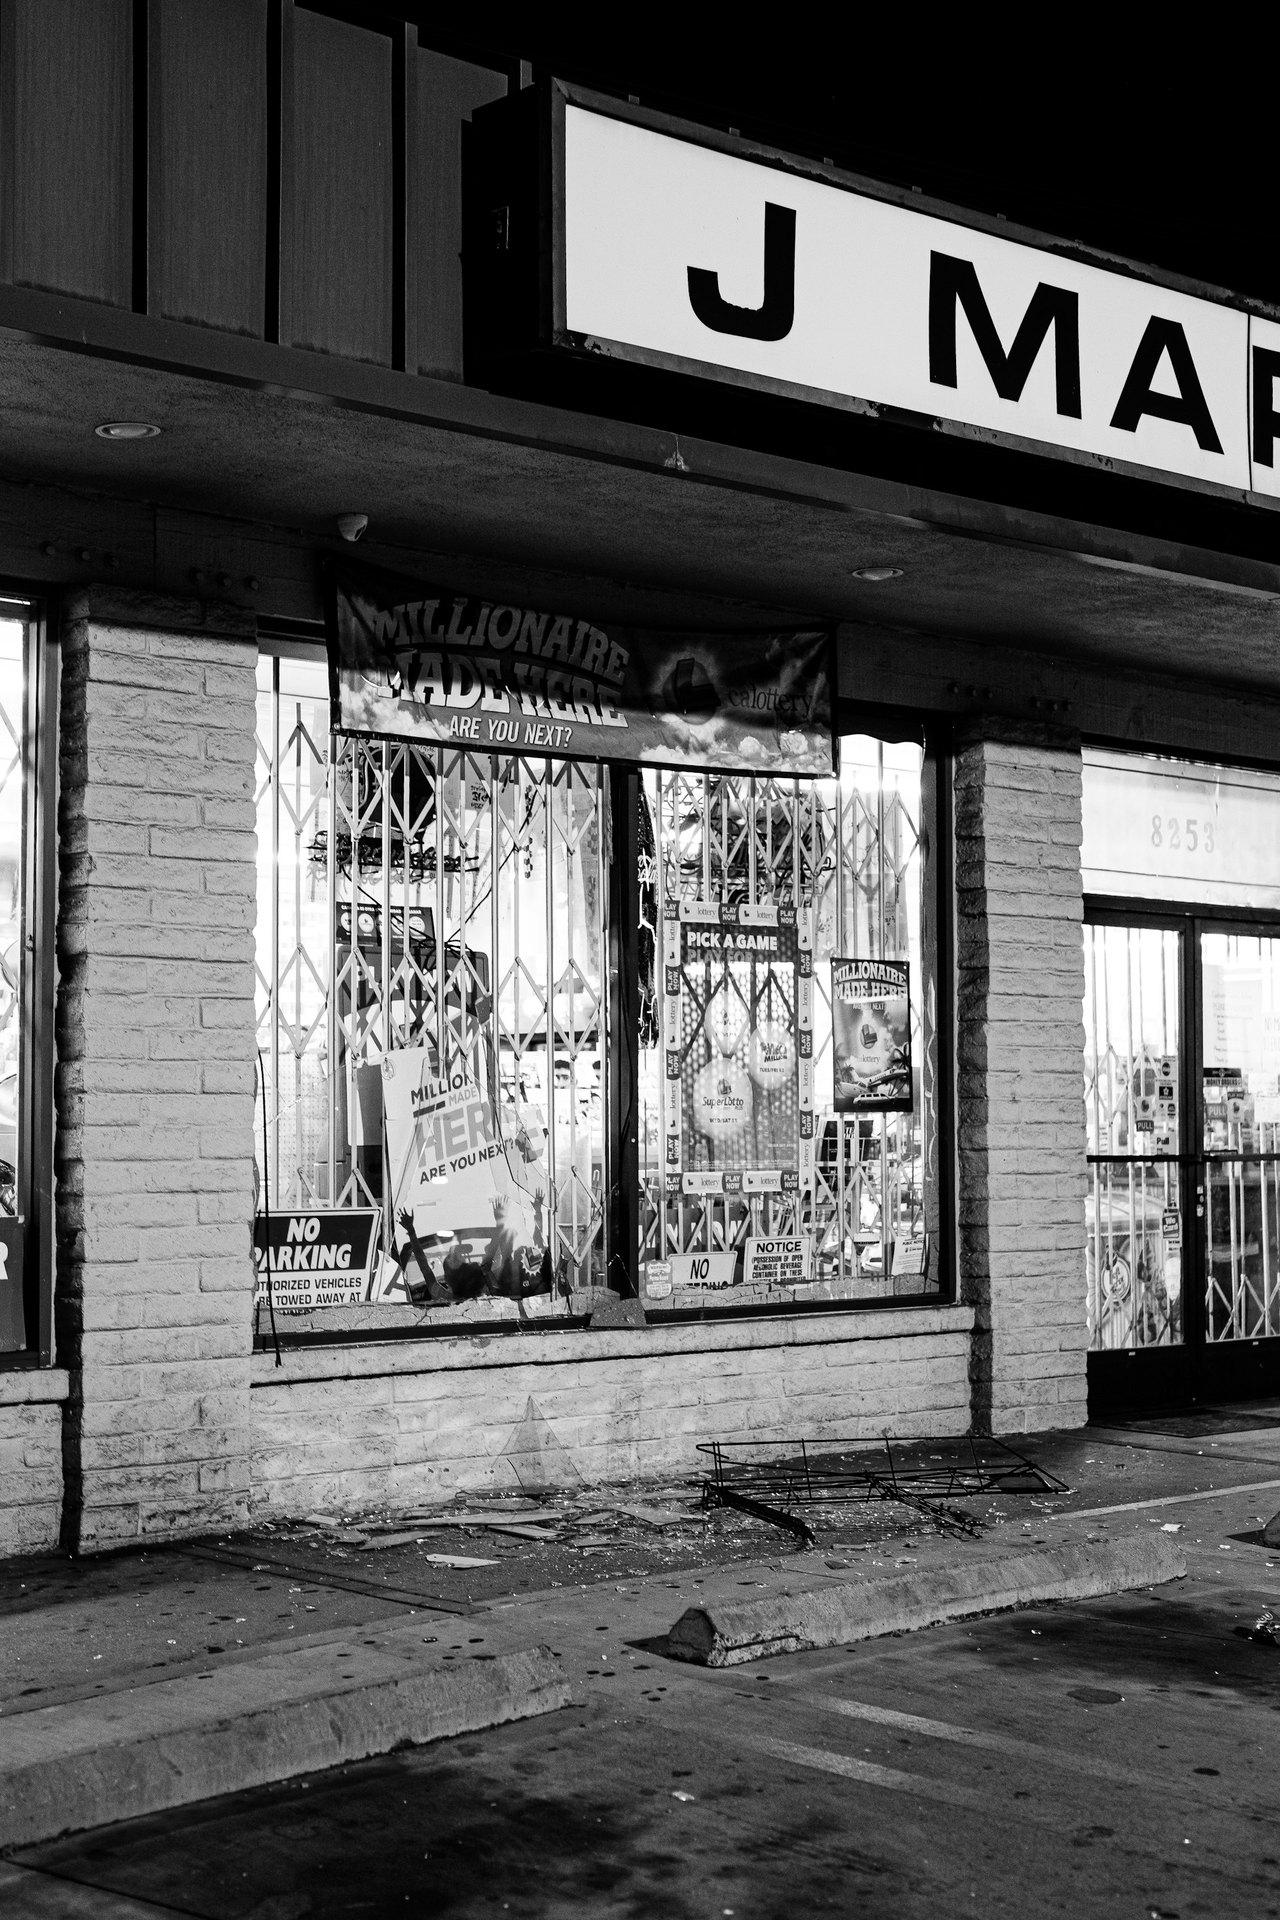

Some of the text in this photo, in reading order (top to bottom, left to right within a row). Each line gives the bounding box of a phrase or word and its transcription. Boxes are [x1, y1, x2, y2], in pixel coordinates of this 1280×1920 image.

[687, 200, 797, 342] J
[374, 597, 631, 685] MILLIONAIRE
[377, 651, 629, 728] MADE HERE
[727, 684, 813, 719] calottery
[450, 715, 573, 748] ARE YOU NEXT?
[1151, 814, 1215, 854] 8253
[697, 905, 716, 917] lottery
[757, 910, 774, 921] lottery
[687, 932, 777, 950] PICK A GAME
[833, 961, 907, 986] MILLIONAIRE
[834, 981, 907, 999] MADE HERE
[862, 1055, 881, 1065] lottery
[449, 1087, 478, 1106] MADE
[702, 1096, 744, 1109] SuperLotto
[1208, 1106, 1227, 1116] PULL
[1137, 1121, 1154, 1130] PULL
[1157, 1137, 1169, 1145] Pull
[420, 1164, 447, 1184] ARE
[450, 1153, 476, 1172] YOU
[701, 1178, 720, 1188] lottery
[760, 1176, 779, 1187] lottery
[784, 1174, 799, 1182] PLAY
[286, 1217, 321, 1242] NO
[756, 1241, 802, 1253] NOTICE
[792, 1254, 803, 1262] OPEN
[690, 1258, 710, 1280] NO
[314, 1277, 362, 1289] VEHICLES
[276, 1294, 312, 1306] TOWED
[316, 1292, 345, 1304] AWAY
[350, 1291, 362, 1302] AT
